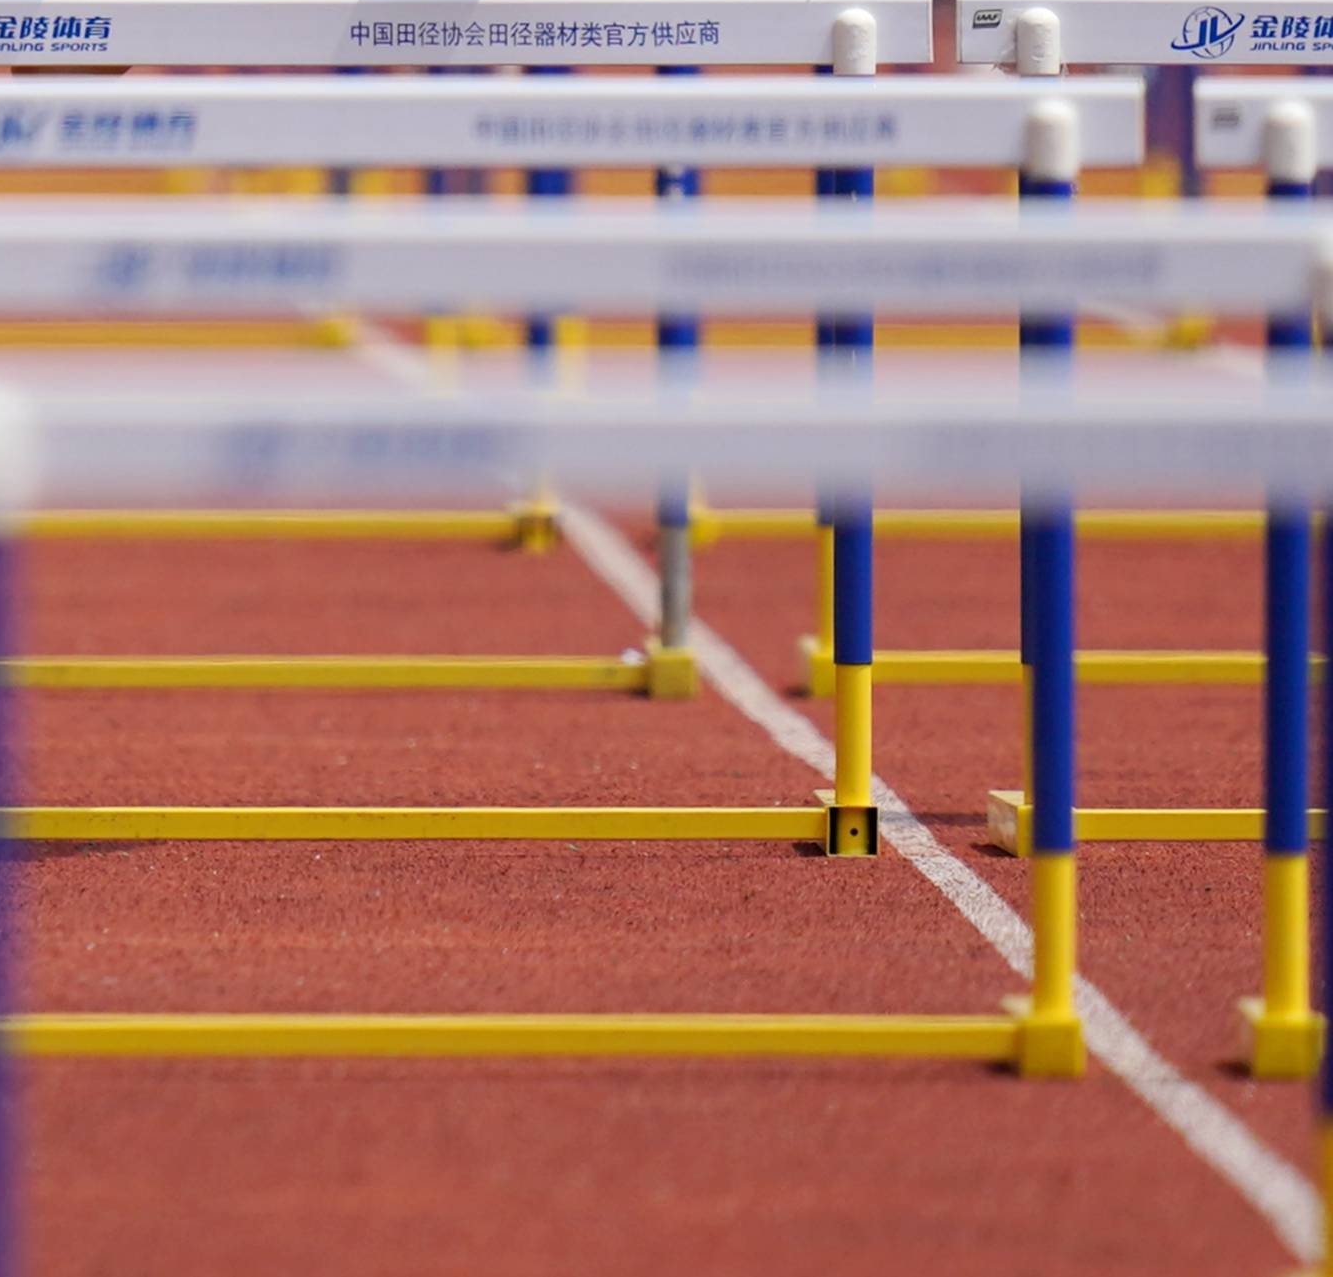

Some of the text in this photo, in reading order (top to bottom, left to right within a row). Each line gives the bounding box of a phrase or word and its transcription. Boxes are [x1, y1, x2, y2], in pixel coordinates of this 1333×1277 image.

[350, 19, 720, 48] 中国田径协会田径器材类官方供应商
[50, 42, 108, 52] SPORTS
[1250, 42, 1333, 51] JINLING SP
